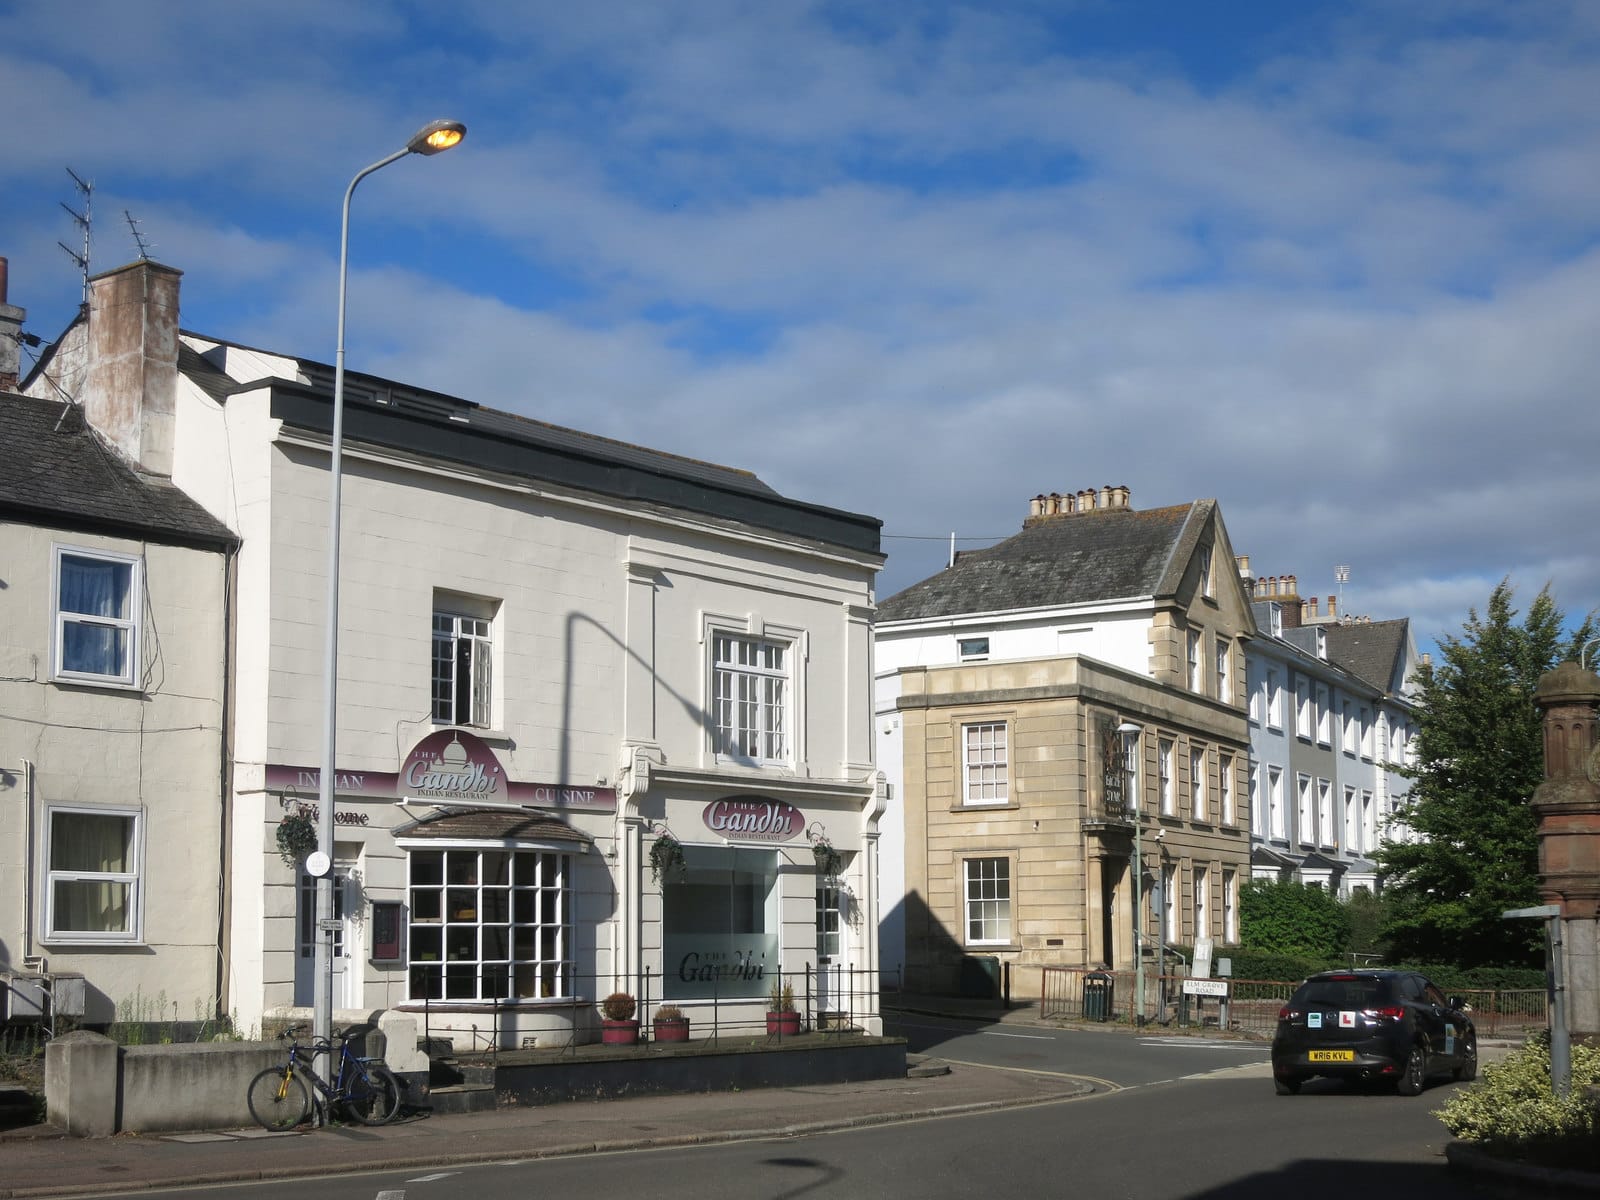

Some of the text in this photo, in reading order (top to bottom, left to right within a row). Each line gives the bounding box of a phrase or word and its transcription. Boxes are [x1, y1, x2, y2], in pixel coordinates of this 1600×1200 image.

[297, 771, 364, 789] INIAN
[406, 760, 499, 793] Gandhi
[417, 789, 490, 800] INDIAN RESTAURANT
[535, 787, 596, 803] CUISINE
[297, 802, 369, 826] Weome
[733, 802, 757, 810] THE
[707, 801, 793, 834] Gandhi
[749, 833, 781, 841] RESTAURANT
[680, 950, 766, 983] Gandhi
[1343, 1015, 1351, 1024] L
[1313, 1052, 1348, 1060] WR16 KVL
